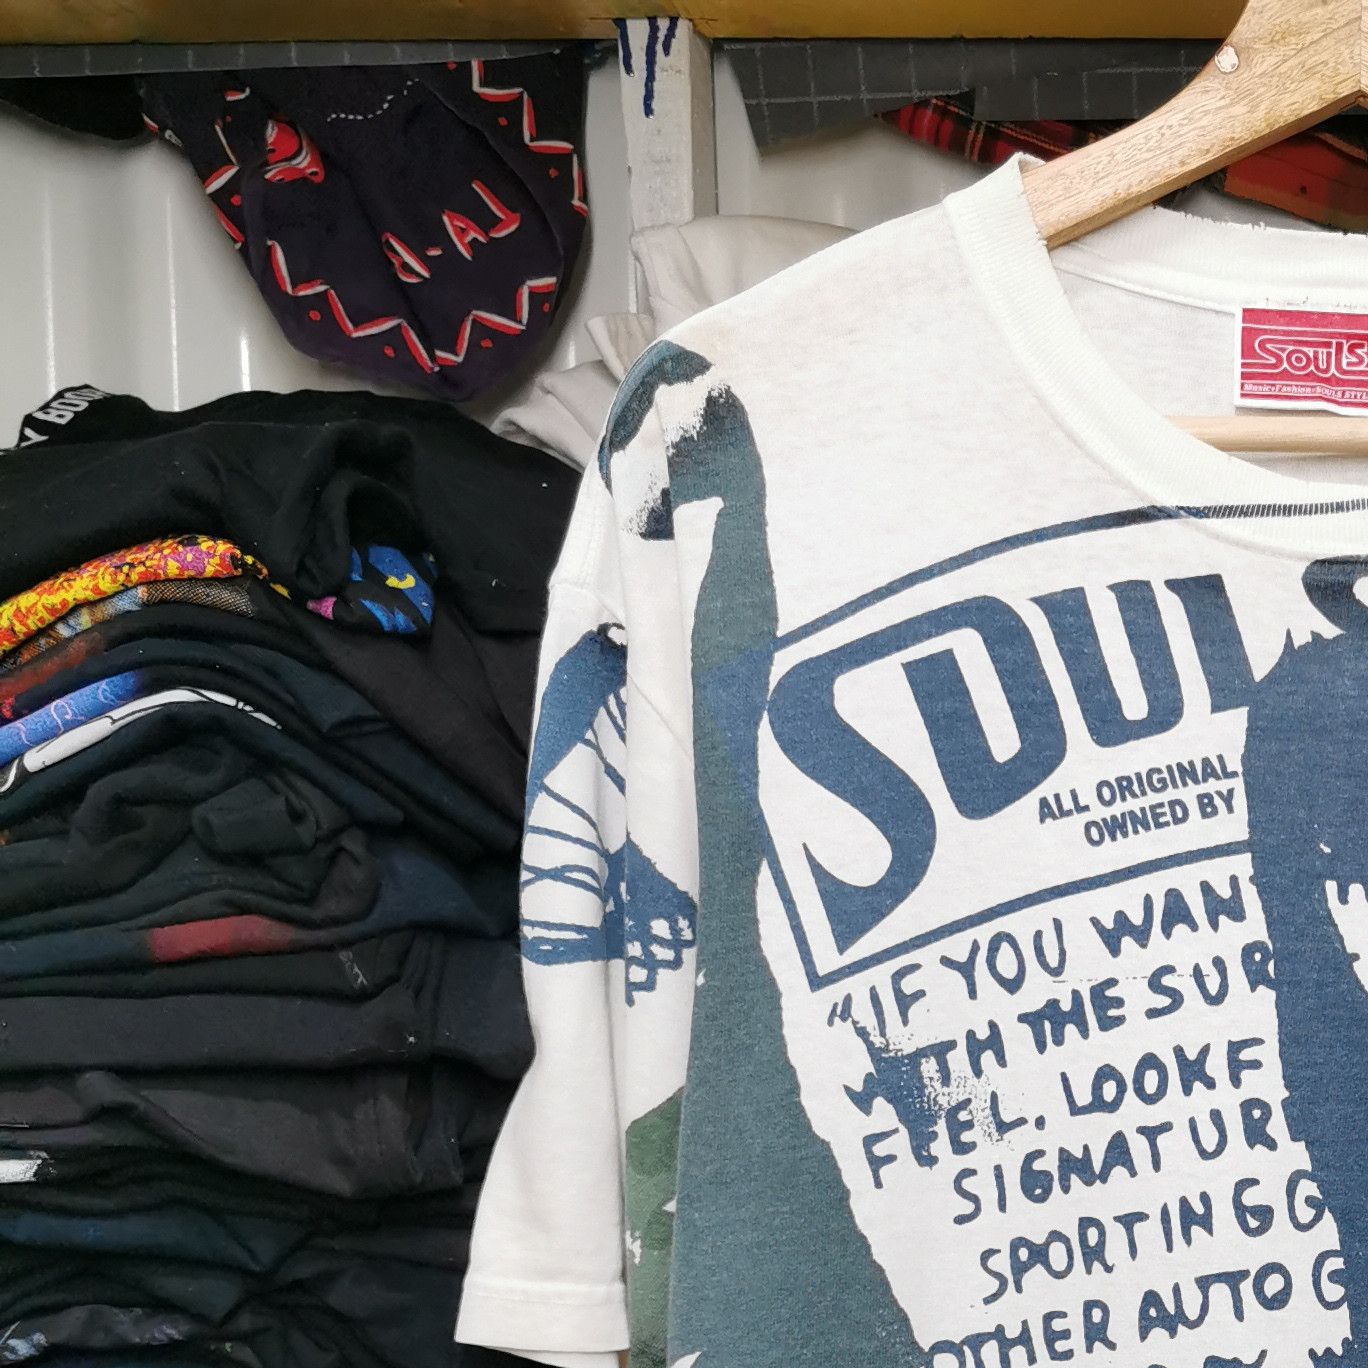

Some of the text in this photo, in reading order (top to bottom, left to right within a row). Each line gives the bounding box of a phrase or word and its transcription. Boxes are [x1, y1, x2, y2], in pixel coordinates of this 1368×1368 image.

[1038, 754, 1239, 824] ALL ORIGINAL
[1084, 788, 1236, 847] OWNED BY
[939, 918, 1067, 1000] YOU
[1089, 873, 1250, 958] WAN
[1017, 978, 1127, 1055] THE
[1145, 940, 1275, 1020] SUR
[1060, 1043, 1217, 1118] LOOK
[953, 1097, 1279, 1225] SIGNATUR
[979, 1177, 1275, 1306] SPORTING
